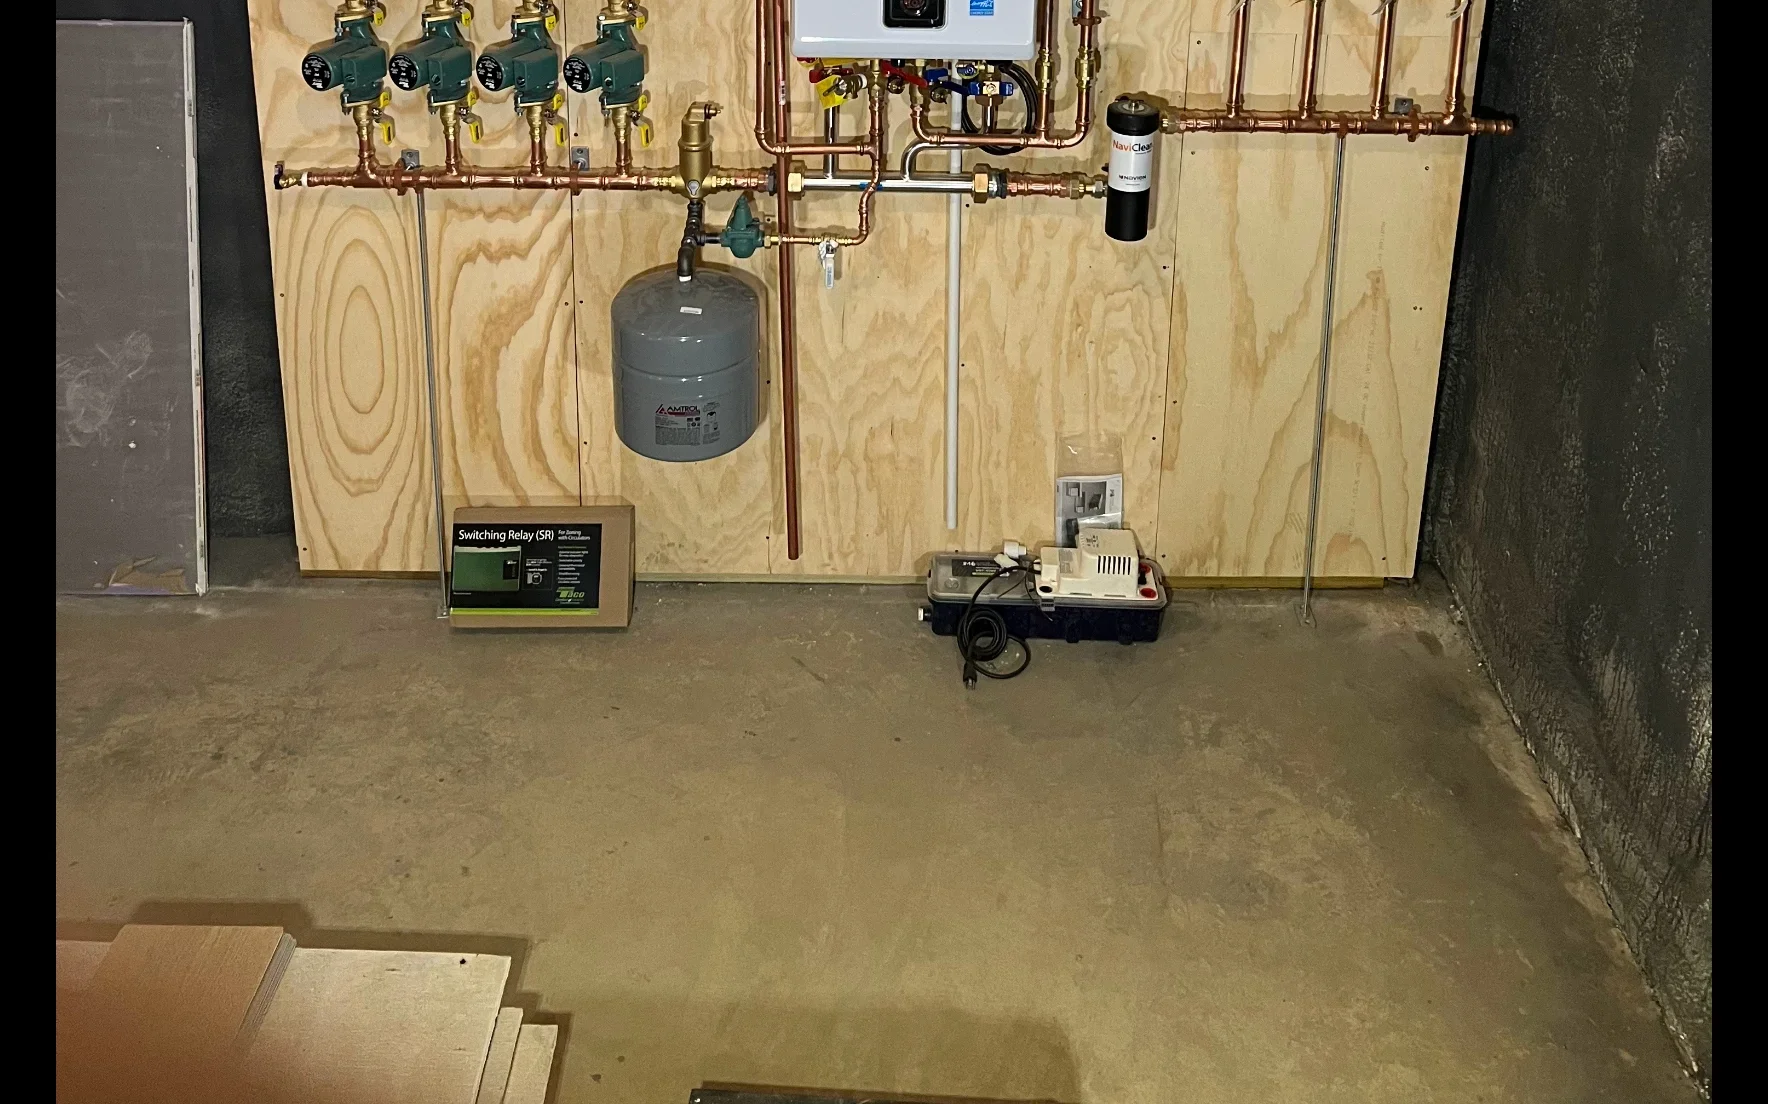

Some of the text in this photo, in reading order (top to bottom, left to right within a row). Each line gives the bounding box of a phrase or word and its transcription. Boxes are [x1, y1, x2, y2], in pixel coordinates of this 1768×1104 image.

[458, 529, 554, 542] Switching Relay (SR)
[556, 586, 585, 598] Taco
